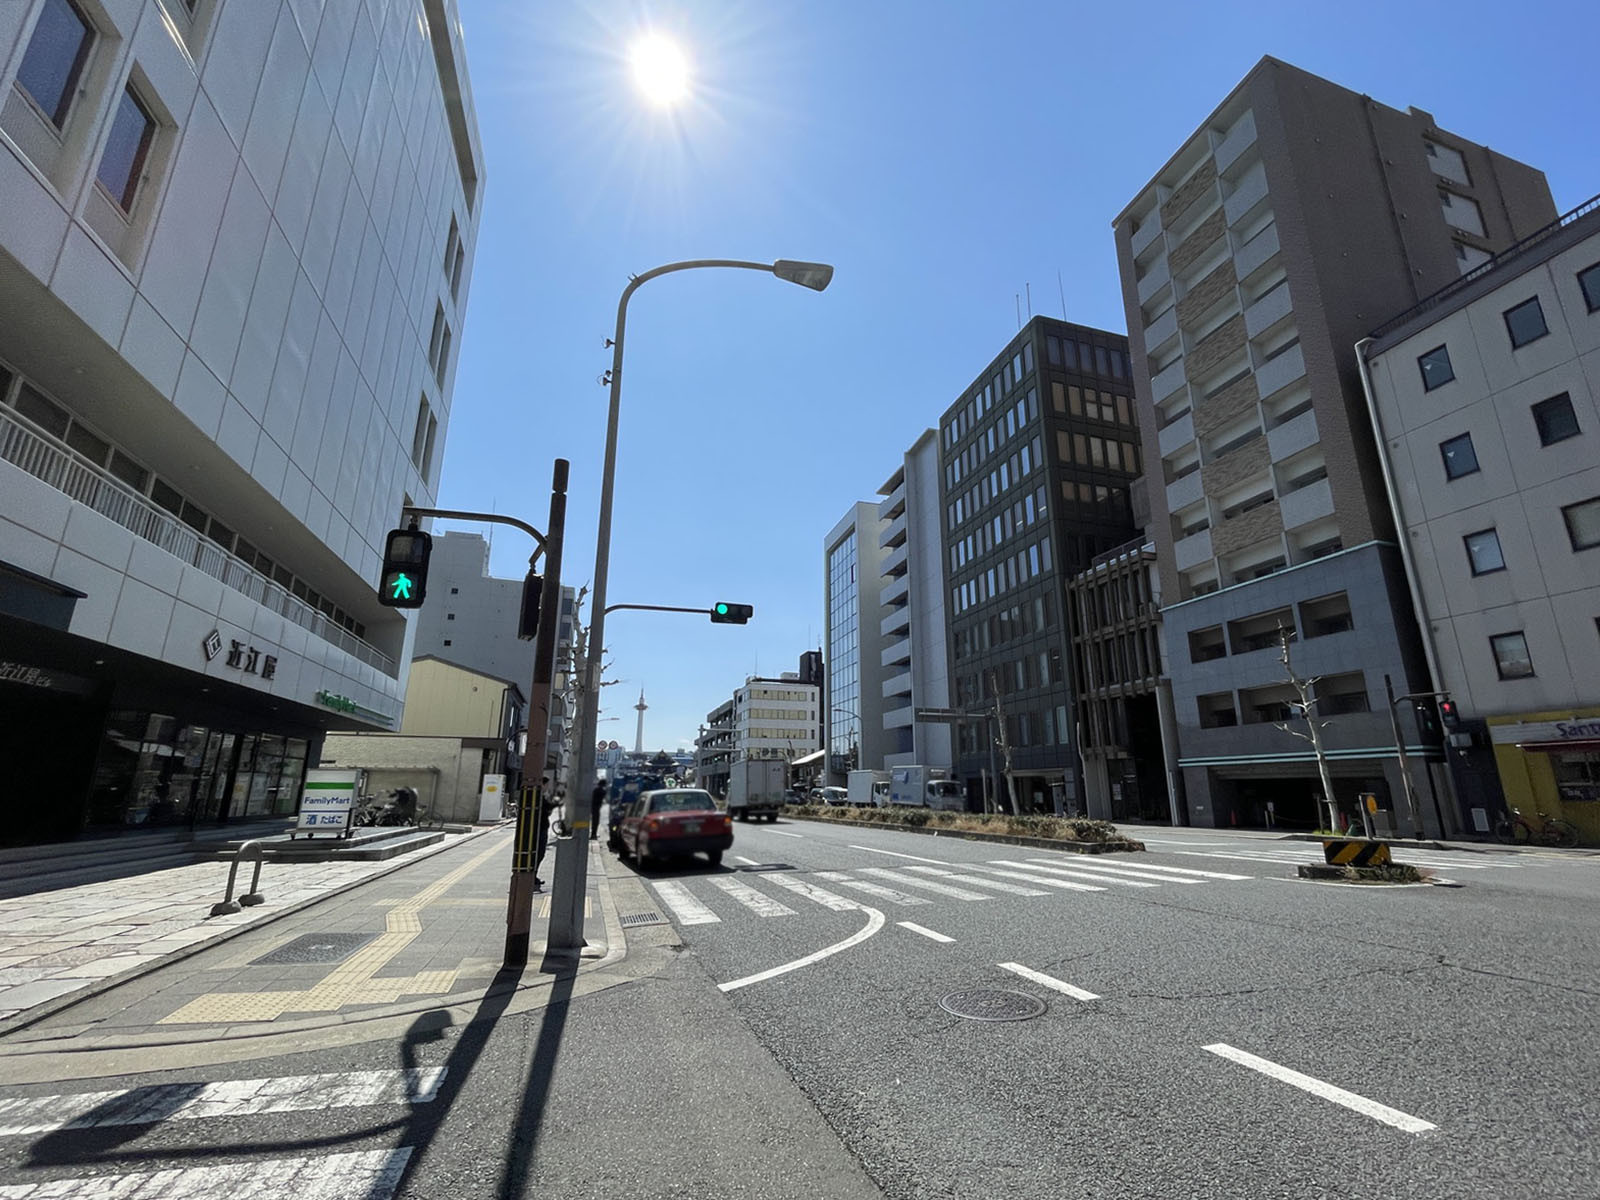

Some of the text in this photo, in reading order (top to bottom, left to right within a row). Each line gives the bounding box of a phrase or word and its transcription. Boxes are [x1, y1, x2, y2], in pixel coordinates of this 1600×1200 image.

[225, 639, 278, 680] 近江屋
[304, 796, 350, 806] FamilyMart
[305, 814, 343, 825] 酒 たばこ
